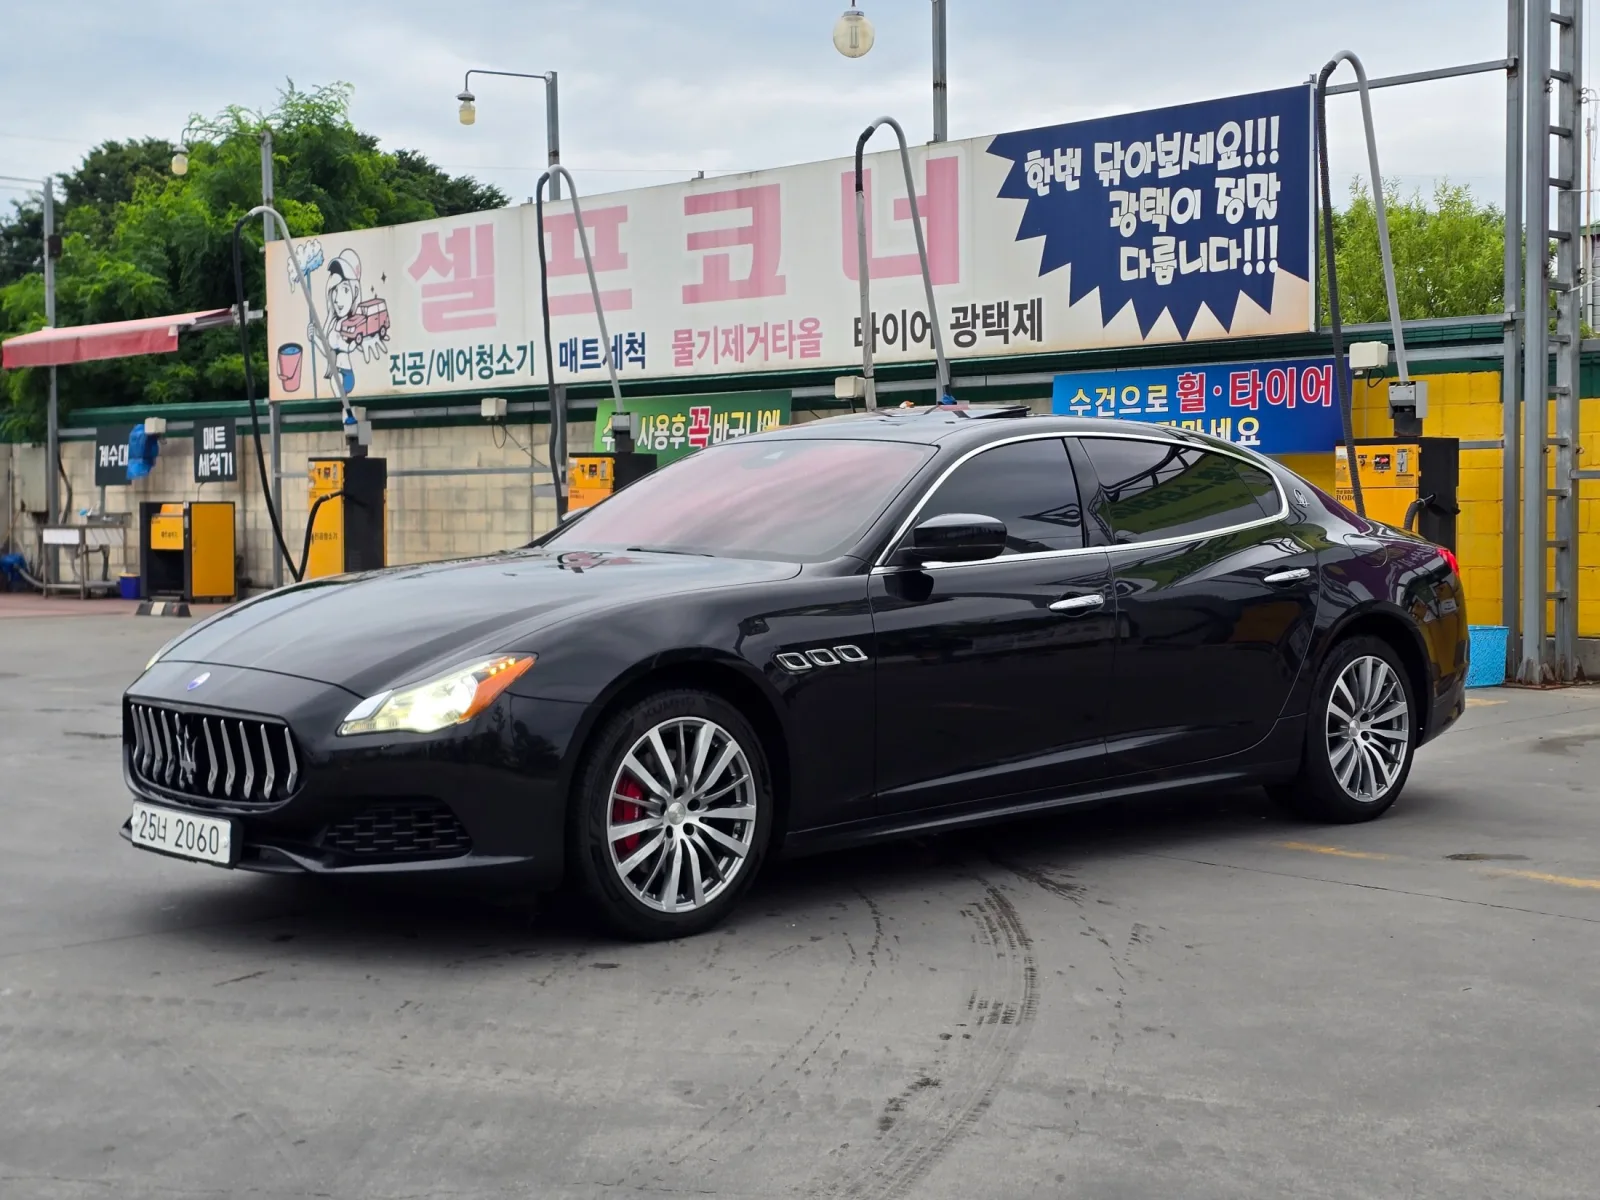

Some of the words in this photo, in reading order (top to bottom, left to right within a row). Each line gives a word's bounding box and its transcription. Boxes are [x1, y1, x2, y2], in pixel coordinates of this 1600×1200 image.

[1024, 147, 1082, 197] 한번
[1094, 115, 1280, 187] 닦아보세요!!!
[1109, 187, 1202, 238] 광택이
[1214, 172, 1281, 225] 정말
[389, 340, 535, 386] 진공/에어청소기
[559, 332, 646, 374] 매트세척
[671, 317, 824, 368] 물기제거타올
[950, 297, 1042, 348] 광택제
[1069, 384, 1169, 417] 수건으로
[203, 426, 226, 450] 매트
[198, 452, 233, 477] 세척기
[139, 810, 167, 843] 25너
[174, 818, 219, 855] 2060
